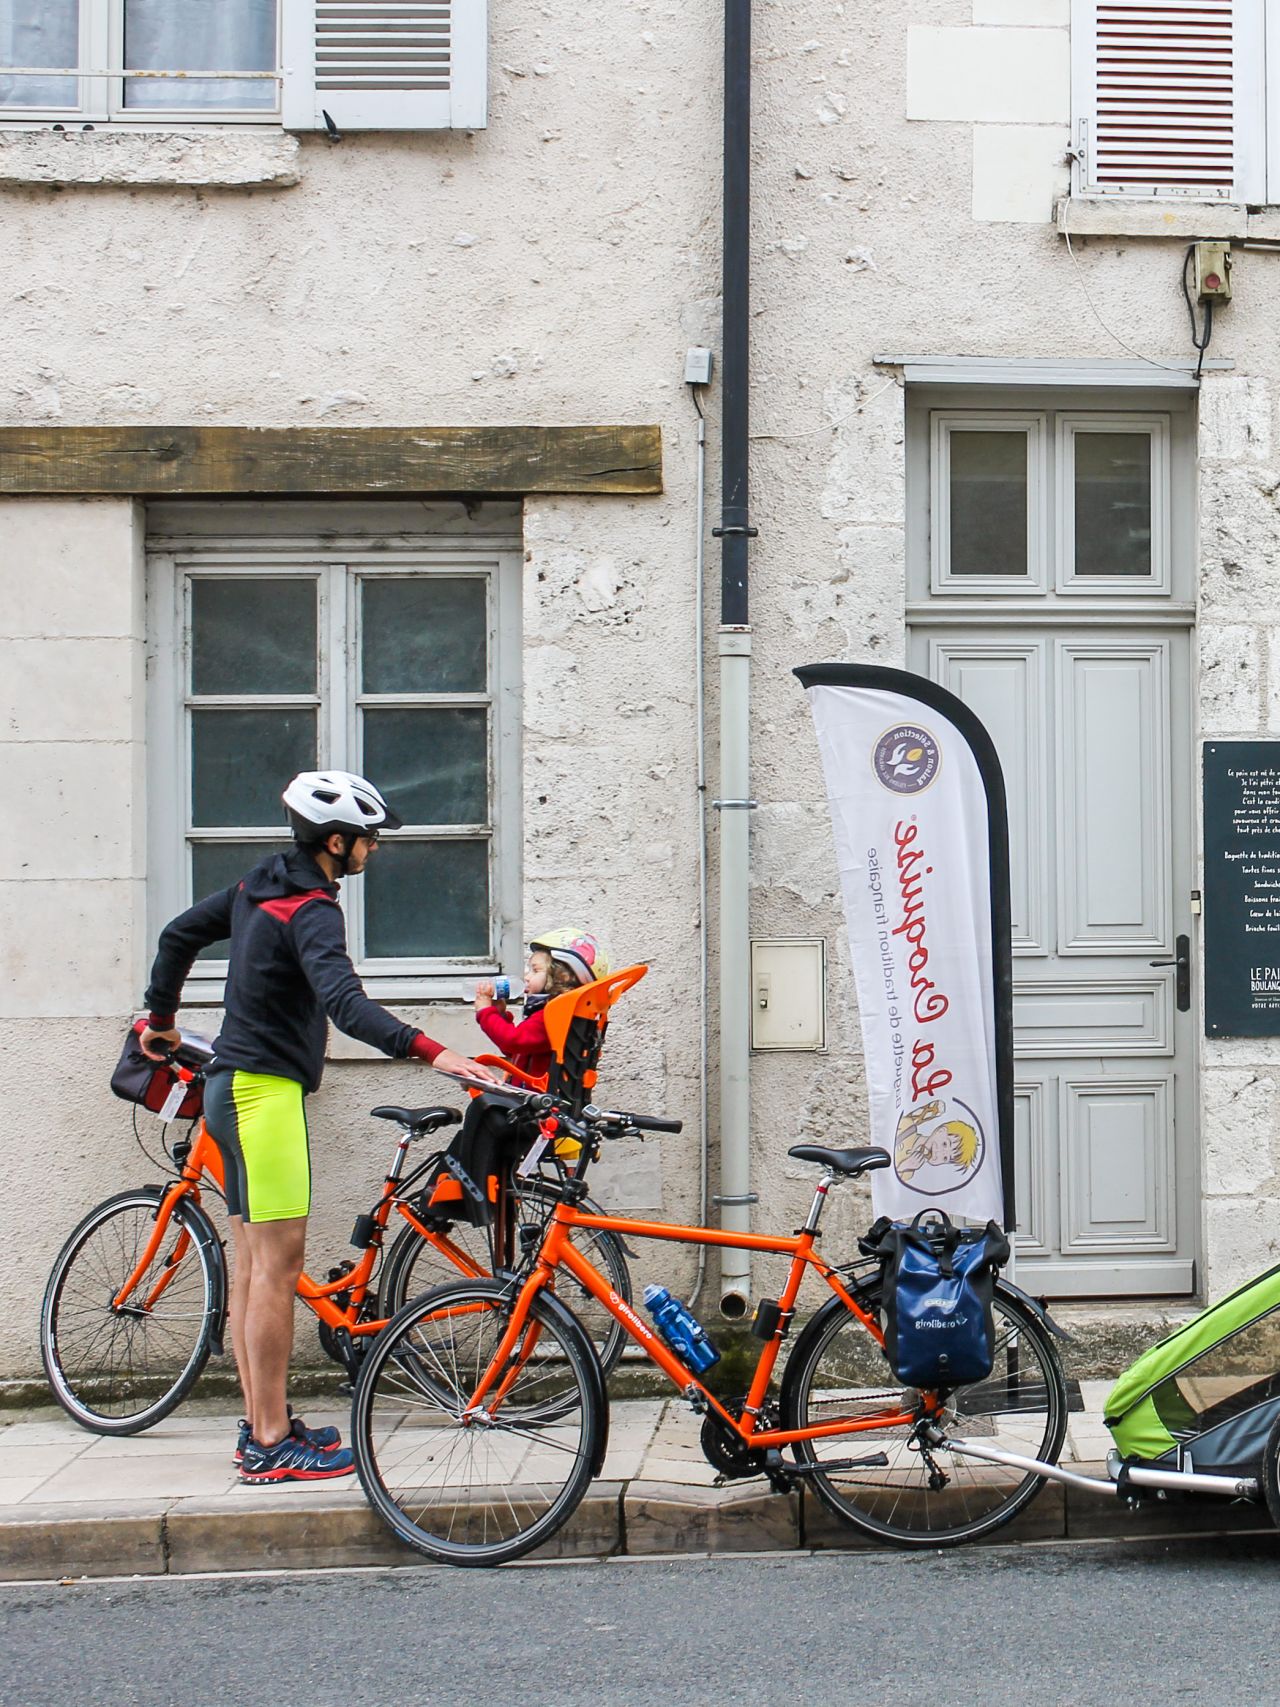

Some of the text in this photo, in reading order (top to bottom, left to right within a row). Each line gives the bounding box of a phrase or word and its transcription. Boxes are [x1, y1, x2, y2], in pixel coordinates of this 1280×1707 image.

[1224, 850, 1248, 861] Baguette
[1242, 865, 1260, 874] Tartes
[1244, 894, 1268, 903] Boissons
[1265, 909, 1272, 917] de
[1250, 967, 1262, 980] LE
